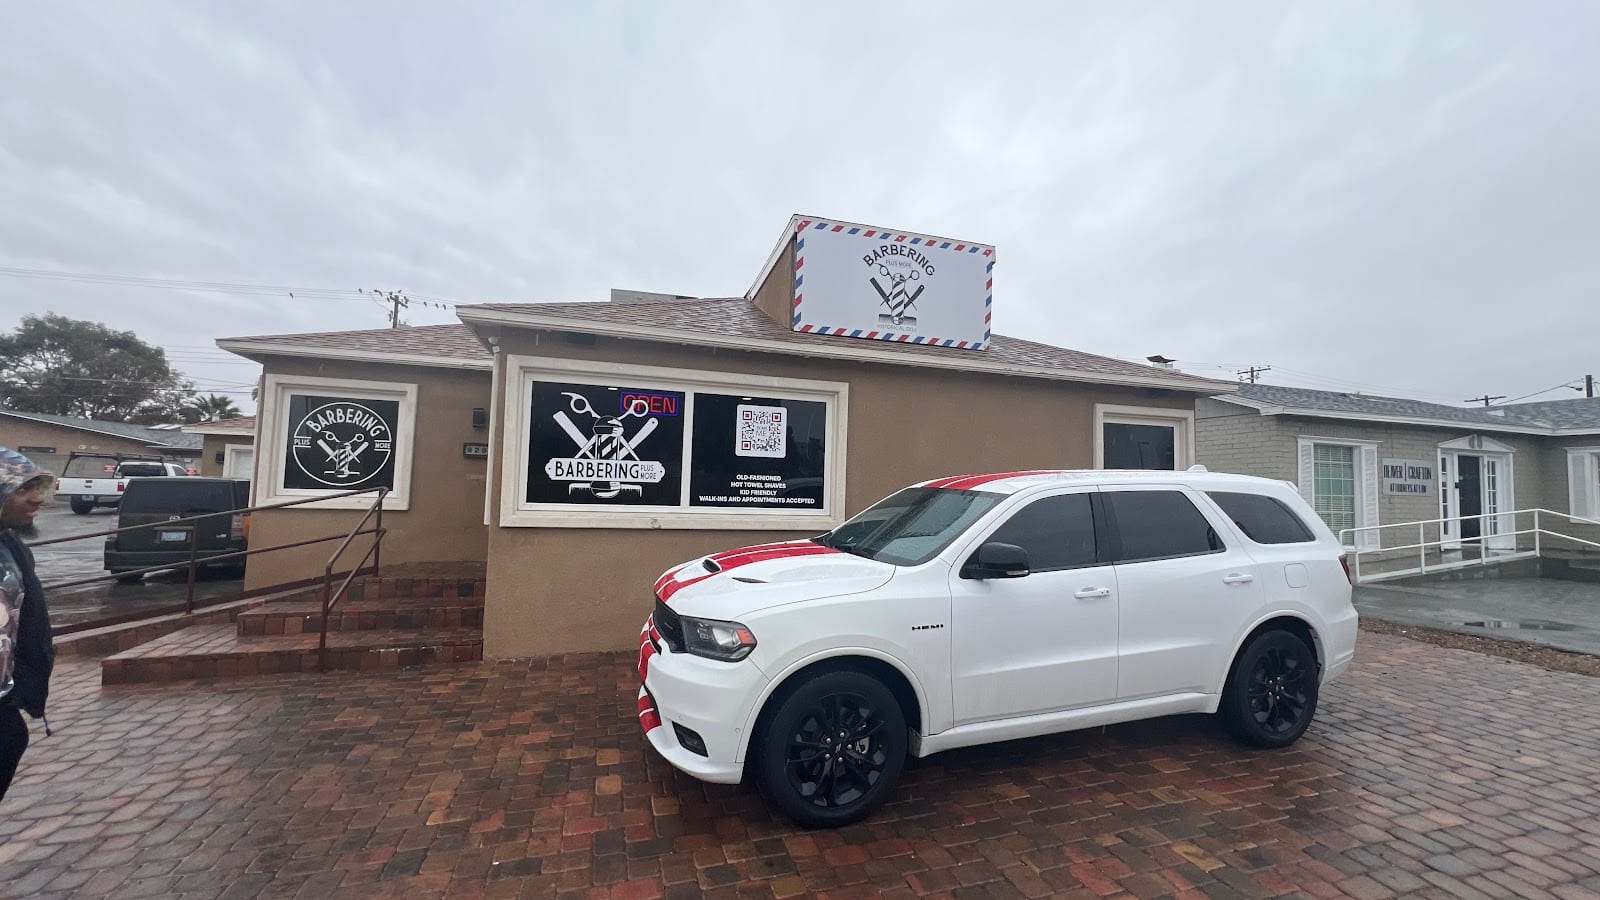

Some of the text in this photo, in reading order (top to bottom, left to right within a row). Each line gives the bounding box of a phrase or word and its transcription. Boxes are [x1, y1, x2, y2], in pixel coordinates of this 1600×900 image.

[863, 244, 935, 276] BARBERING
[623, 394, 676, 413] OPEN
[306, 408, 385, 437] BARBERING
[294, 438, 311, 446] PLUS
[555, 461, 639, 479] BARBERING
[640, 464, 654, 472] PLUS
[640, 472, 657, 480] MORE
[736, 474, 782, 482] OLD-FASHIONED
